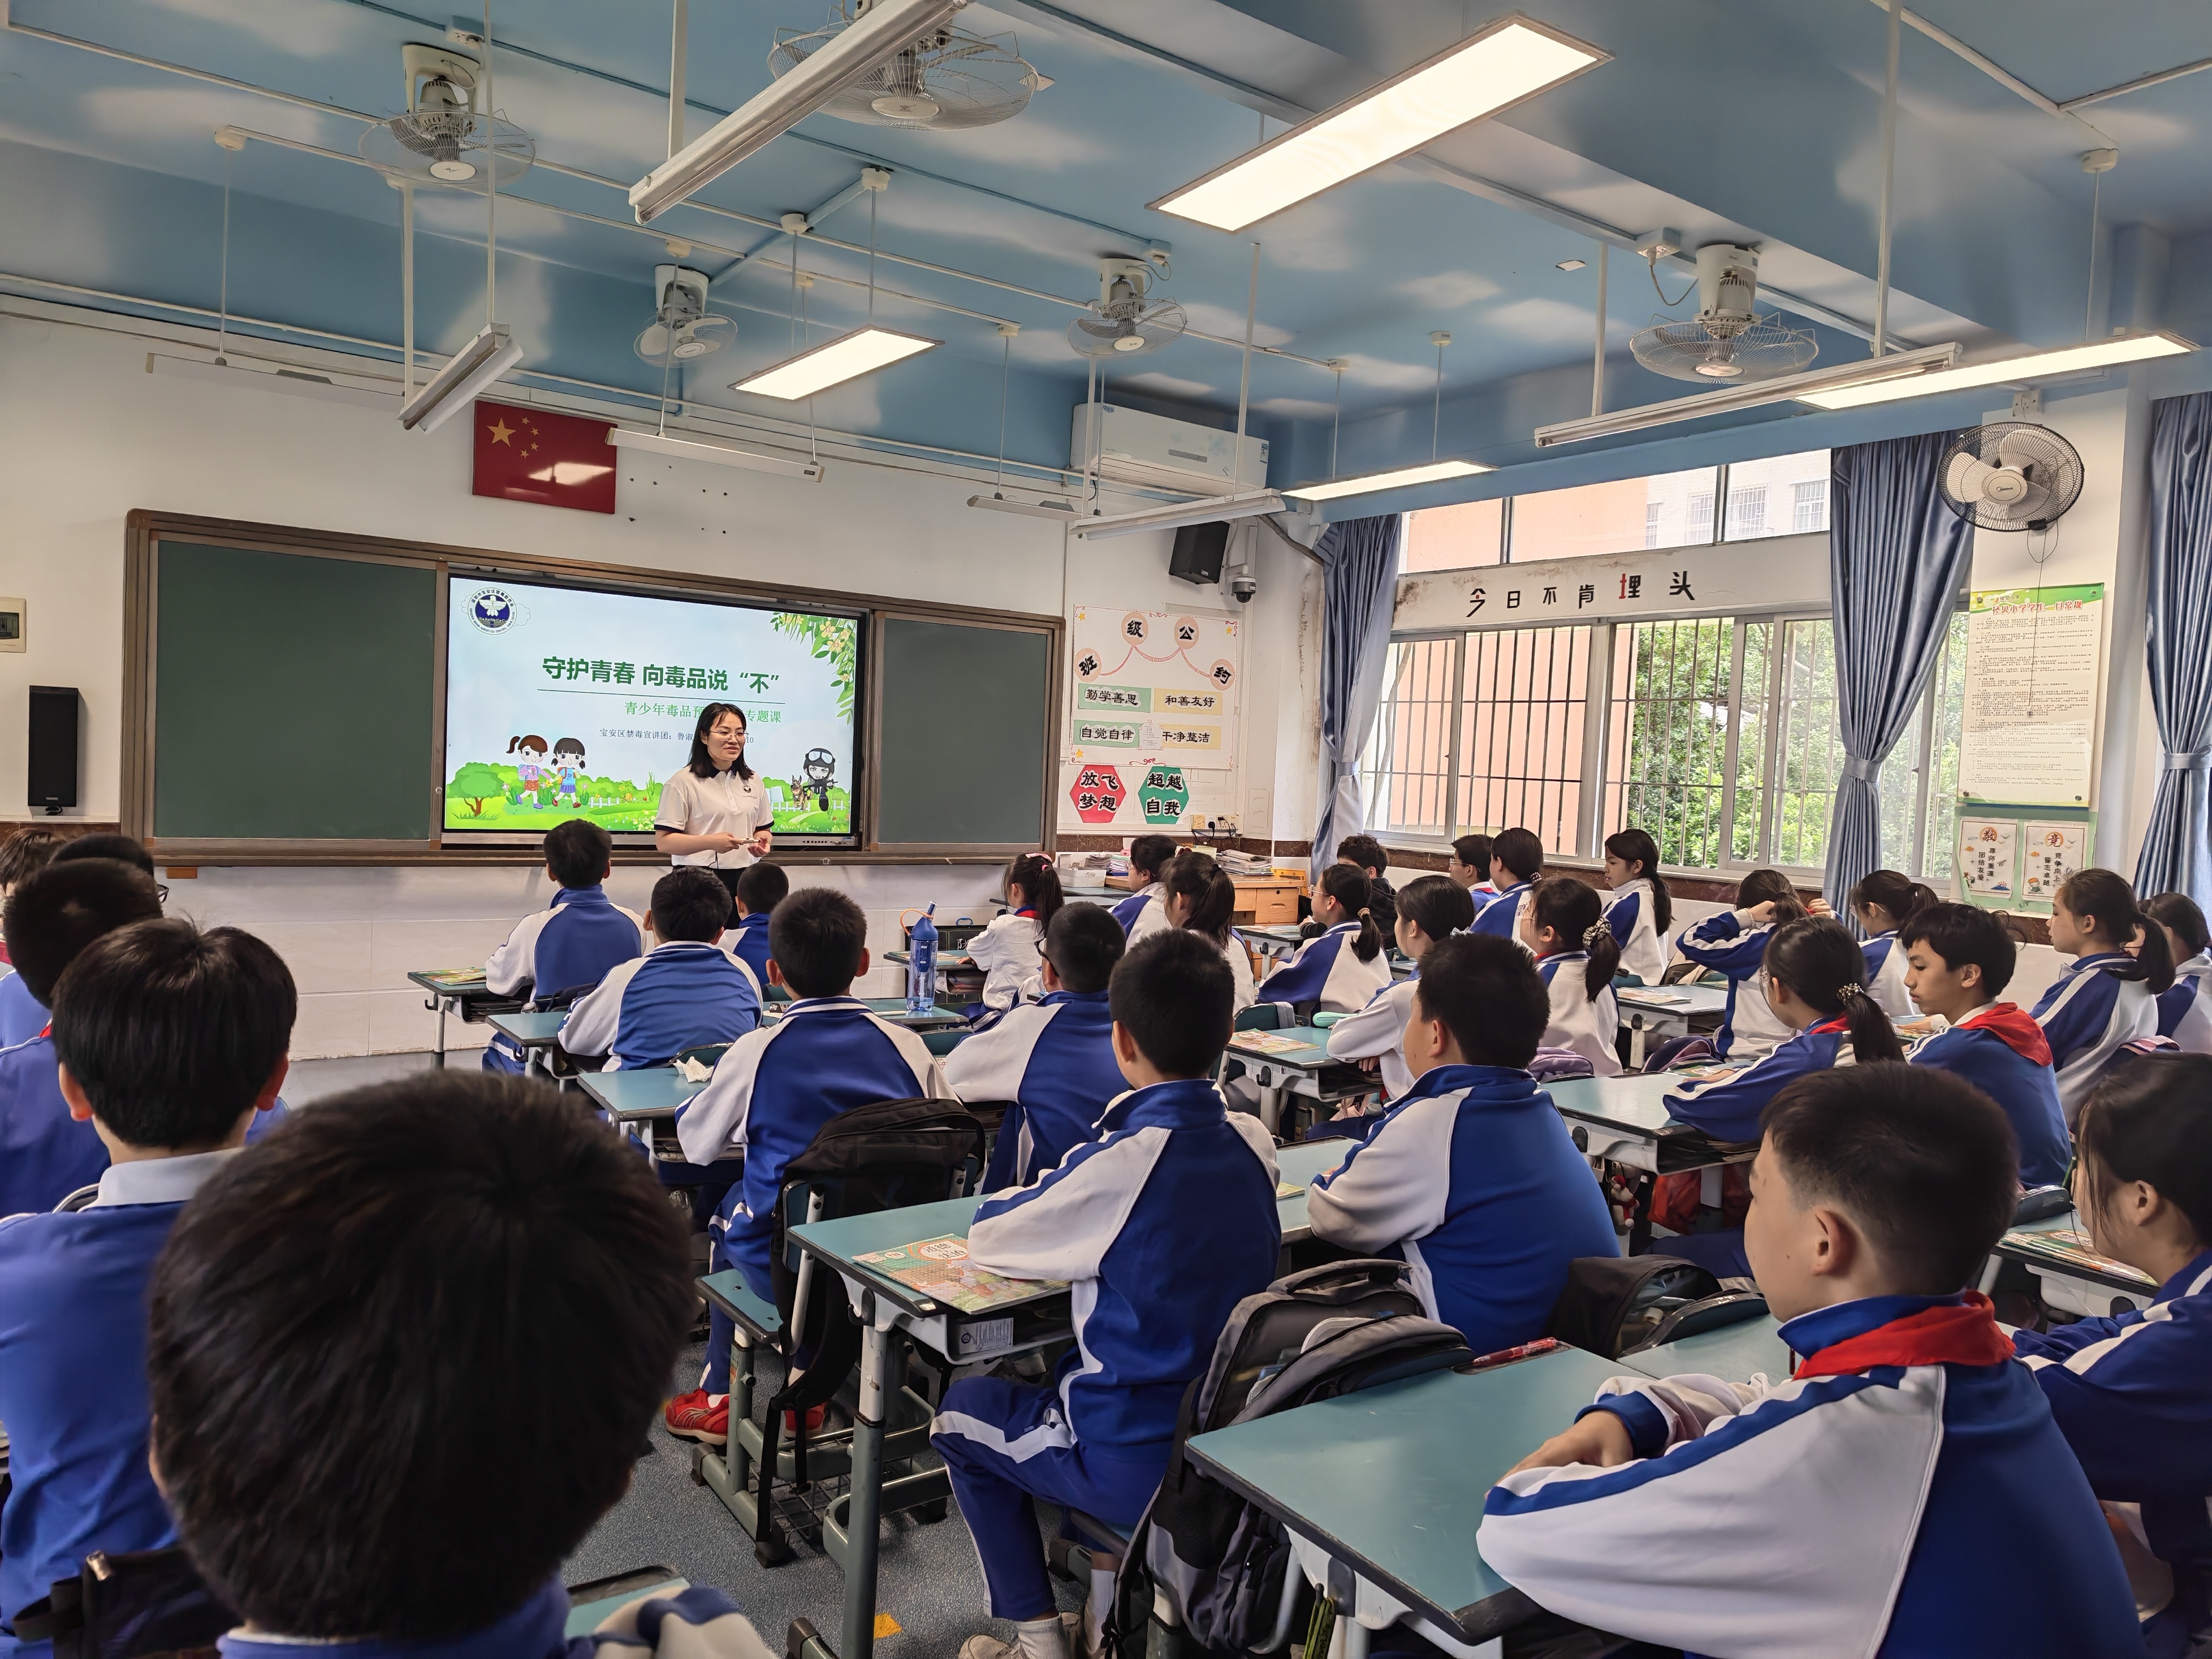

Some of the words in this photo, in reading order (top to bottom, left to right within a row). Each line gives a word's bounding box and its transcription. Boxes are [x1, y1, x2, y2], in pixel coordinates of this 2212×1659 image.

[1466, 570, 1695, 617] 今日不肯埋头
[1992, 600, 2082, 615] 径贝小学学生一日常规
[1078, 620, 1232, 684] 班级公约
[542, 656, 635, 685] 守护青春
[1085, 689, 1139, 706] 勤学善思
[1164, 695, 1216, 707] 和善友好
[1081, 726, 1135, 741] 自觉自律
[1162, 731, 1211, 744] 干净整洁
[1081, 771, 1119, 790] 放飞
[1148, 773, 1183, 790] 超越
[1079, 794, 1117, 811] 梦想
[1147, 799, 1181, 815] 自我
[1982, 828, 1996, 842] 敬
[1977, 852, 1985, 881] 团结友爱
[1986, 848, 1996, 876] 尊师重道
